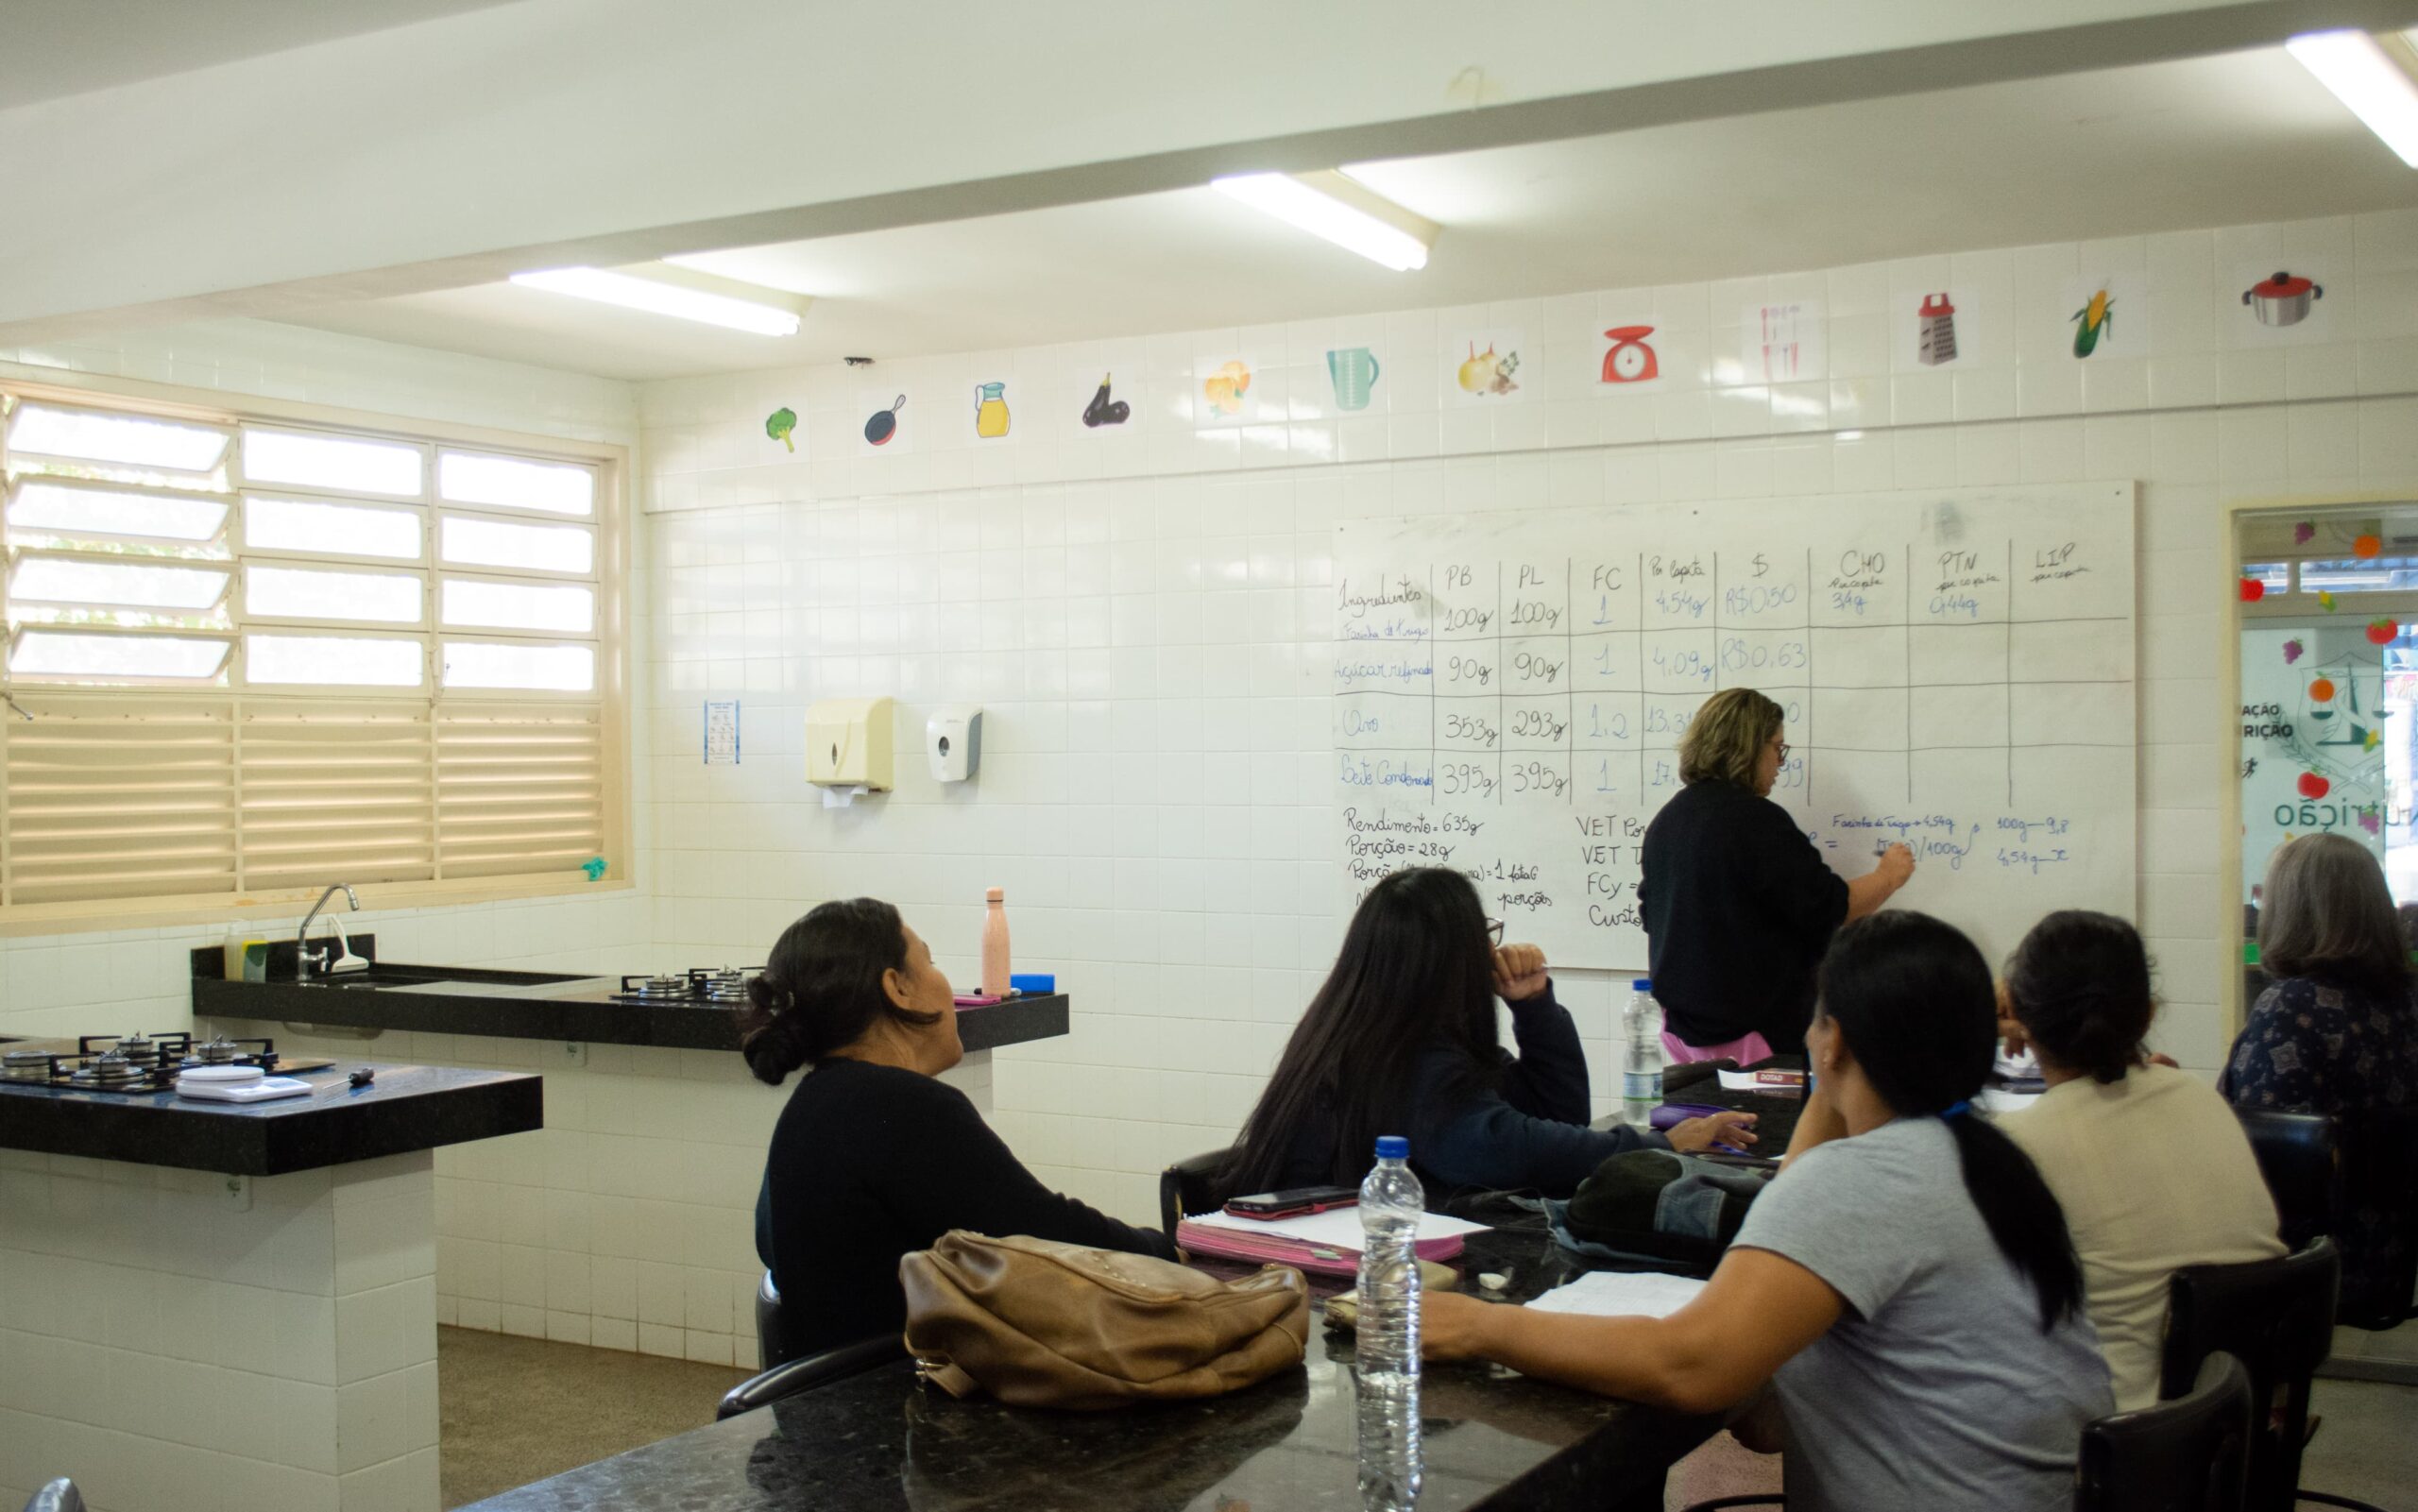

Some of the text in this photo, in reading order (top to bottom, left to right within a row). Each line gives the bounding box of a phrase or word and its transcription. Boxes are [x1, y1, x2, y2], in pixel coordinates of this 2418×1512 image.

[1752, 552, 1769, 578] $
[1840, 550, 1885, 577] CHO
[1938, 552, 1978, 579] PTN
[2035, 542, 2076, 568] LIP
[1445, 565, 1473, 590] PB
[1518, 565, 1544, 588] PL
[1592, 565, 1622, 590] FC
[1444, 607, 1494, 633] 100g
[1510, 598, 1563, 629] 100g
[1592, 594, 1613, 625] 1
[1448, 655, 1493, 686] 90g
[1514, 652, 1564, 683] 90g
[1592, 643, 1616, 674] 1
[1342, 709, 1379, 737] Ovo
[2241, 703, 2280, 718] AÇÃO
[1445, 714, 1499, 747] 353g
[1511, 710, 1568, 742] 293g
[2243, 722, 2293, 741] RIÇÃO
[1441, 763, 1499, 798] 395g
[1511, 761, 1569, 796] 395g
[1596, 758, 1617, 791] 1
[1442, 812, 1485, 836] 635g
[1575, 815, 1617, 837] VET
[1997, 817, 2026, 842] 100g
[1419, 842, 1456, 861] 28g
[1582, 845, 1621, 865] VET
[1494, 858, 1505, 880] 1
[1497, 892, 1553, 912] porções
